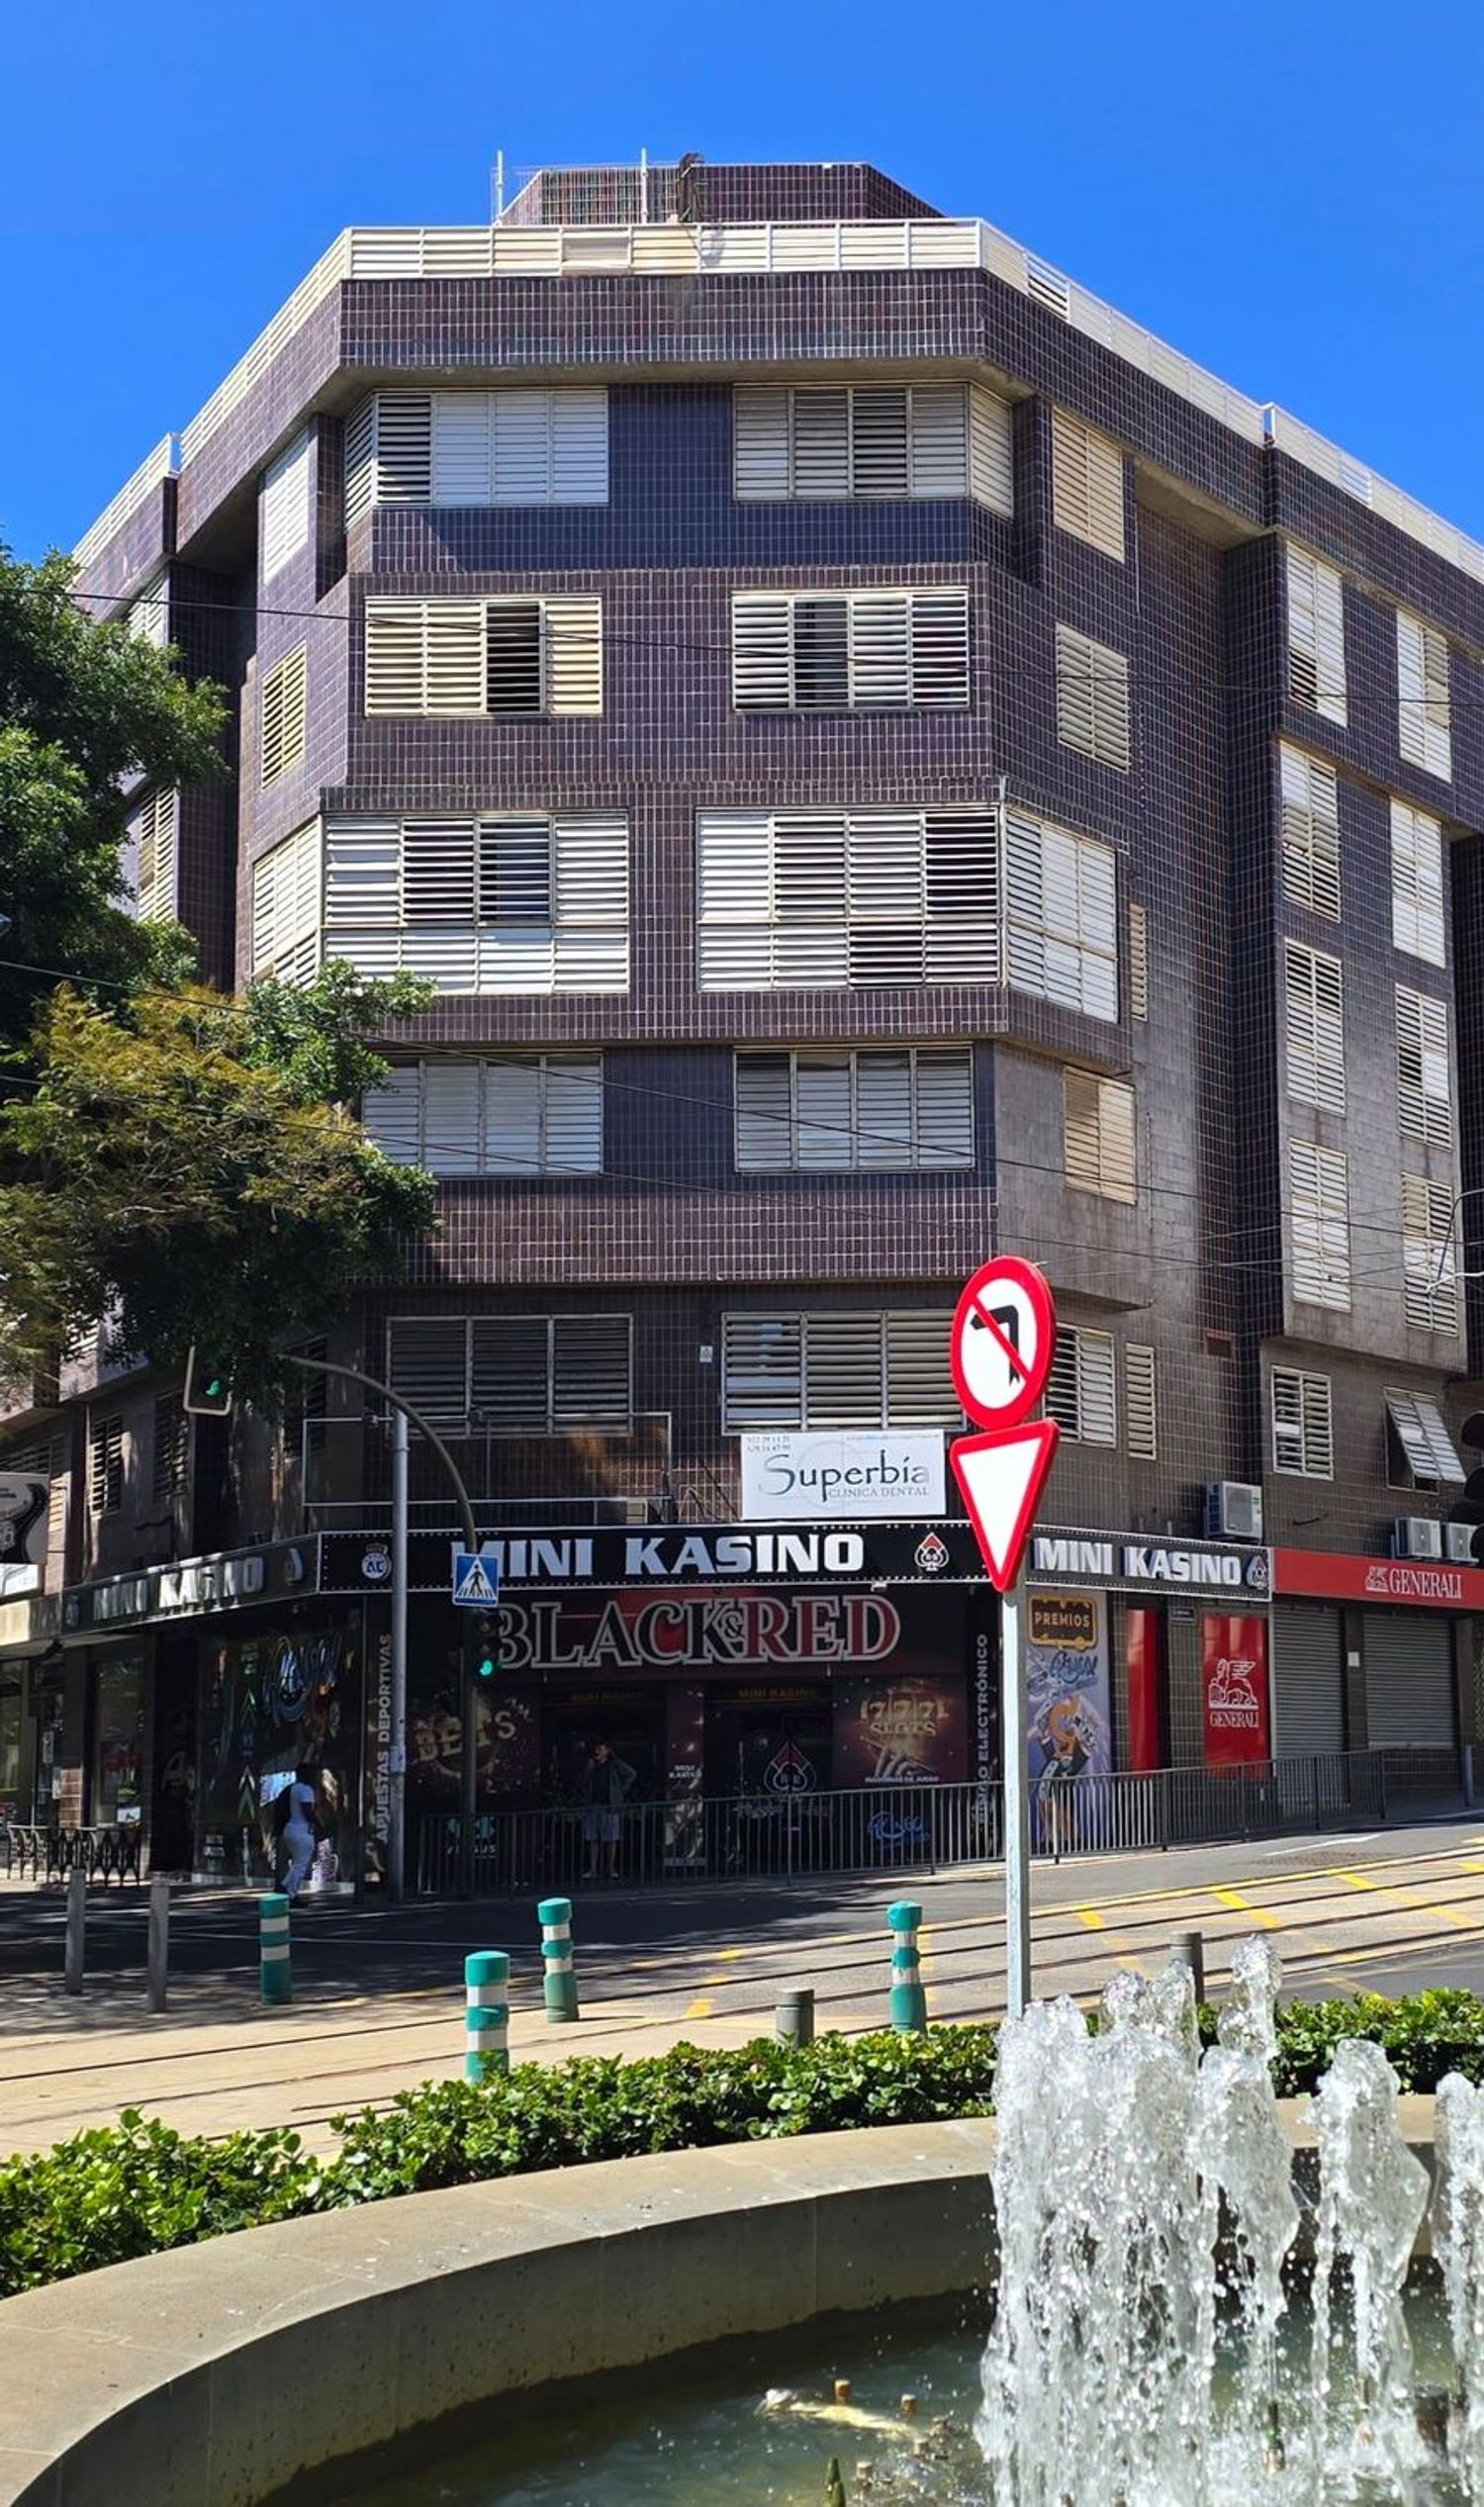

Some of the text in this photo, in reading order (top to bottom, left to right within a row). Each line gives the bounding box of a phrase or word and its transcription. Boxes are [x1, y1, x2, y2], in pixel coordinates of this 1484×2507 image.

[881, 1487, 930, 1497] DENTAL
[623, 1532, 864, 1576] KASINO
[1033, 1536, 1242, 1587] MINI KASINO
[1388, 1568, 1463, 1600] GENERALI
[1034, 1612, 1090, 1627] PREMIOS
[974, 1633, 989, 1761] ELECTRÓNICO
[870, 1719, 937, 1736] SLOTS
[1209, 1711, 1259, 1728] GENERALI
[375, 1632, 392, 1843] APUESTAS DEPORTIVAS
